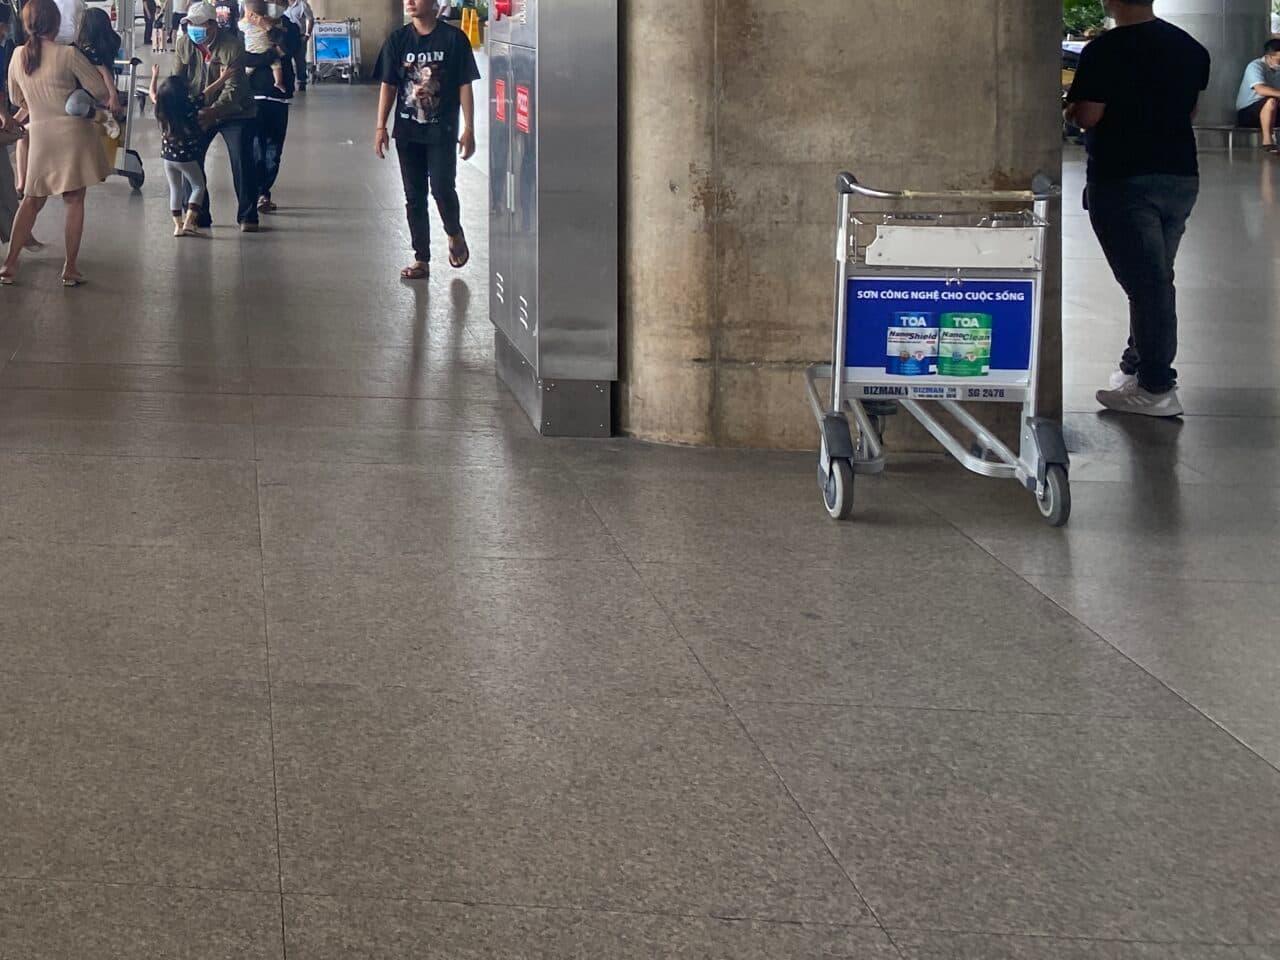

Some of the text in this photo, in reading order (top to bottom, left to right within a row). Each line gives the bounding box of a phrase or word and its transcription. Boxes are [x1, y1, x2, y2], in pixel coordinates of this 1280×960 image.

[856, 289, 1025, 303] SƠN CÔNG NGHỆ CHO CUỘC SỐNG
[900, 316, 927, 327] TOA
[953, 317, 980, 328] TOA
